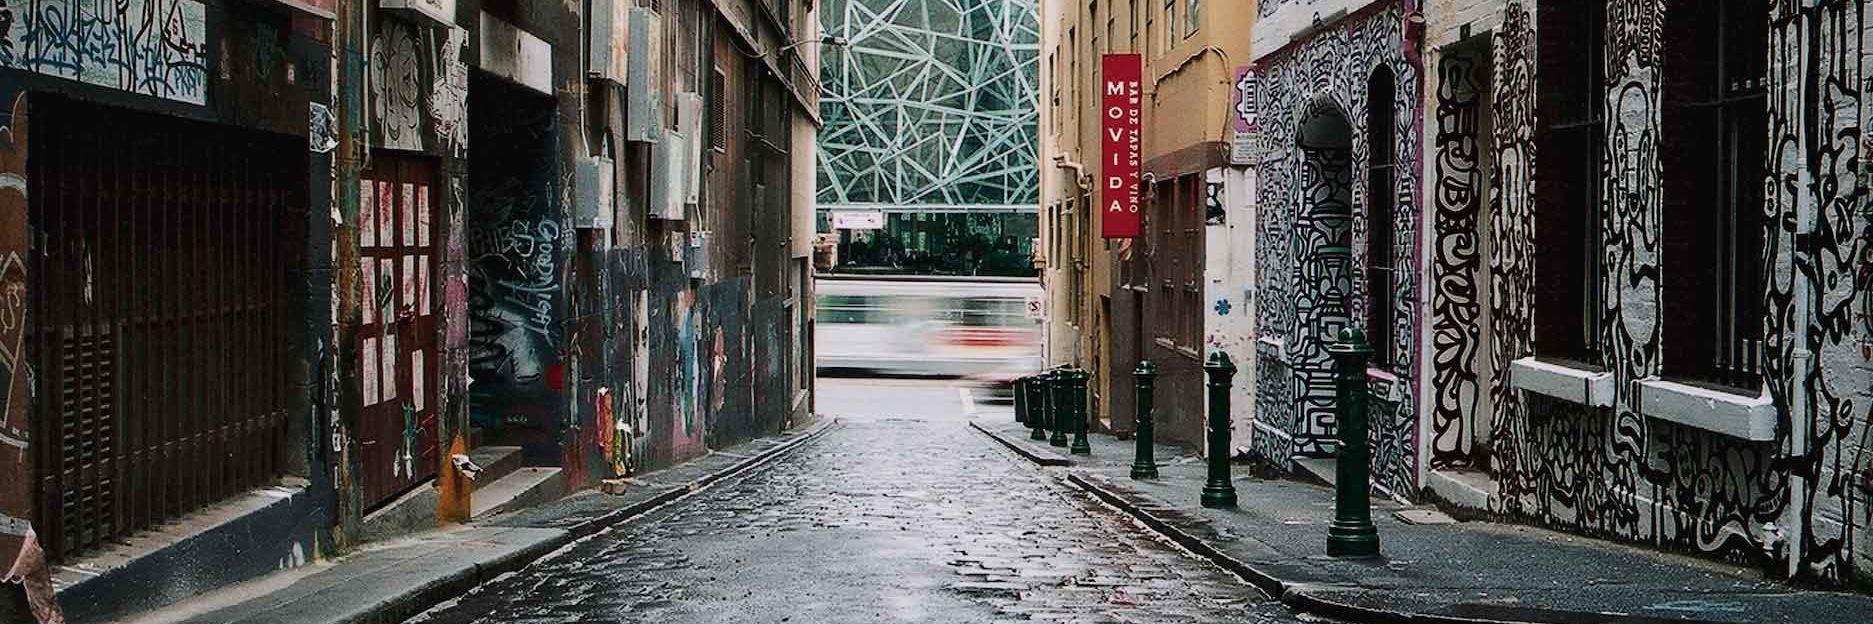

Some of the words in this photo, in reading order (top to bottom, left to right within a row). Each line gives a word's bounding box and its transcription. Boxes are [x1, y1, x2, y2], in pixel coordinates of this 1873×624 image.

[1129, 81, 1139, 104] BAR
[1129, 109, 1139, 125] DE
[1107, 81, 1125, 212] MOVIDA
[1129, 128, 1139, 166] TAPAS
[1129, 171, 1139, 179] Y
[1129, 183, 1139, 213] VINO
